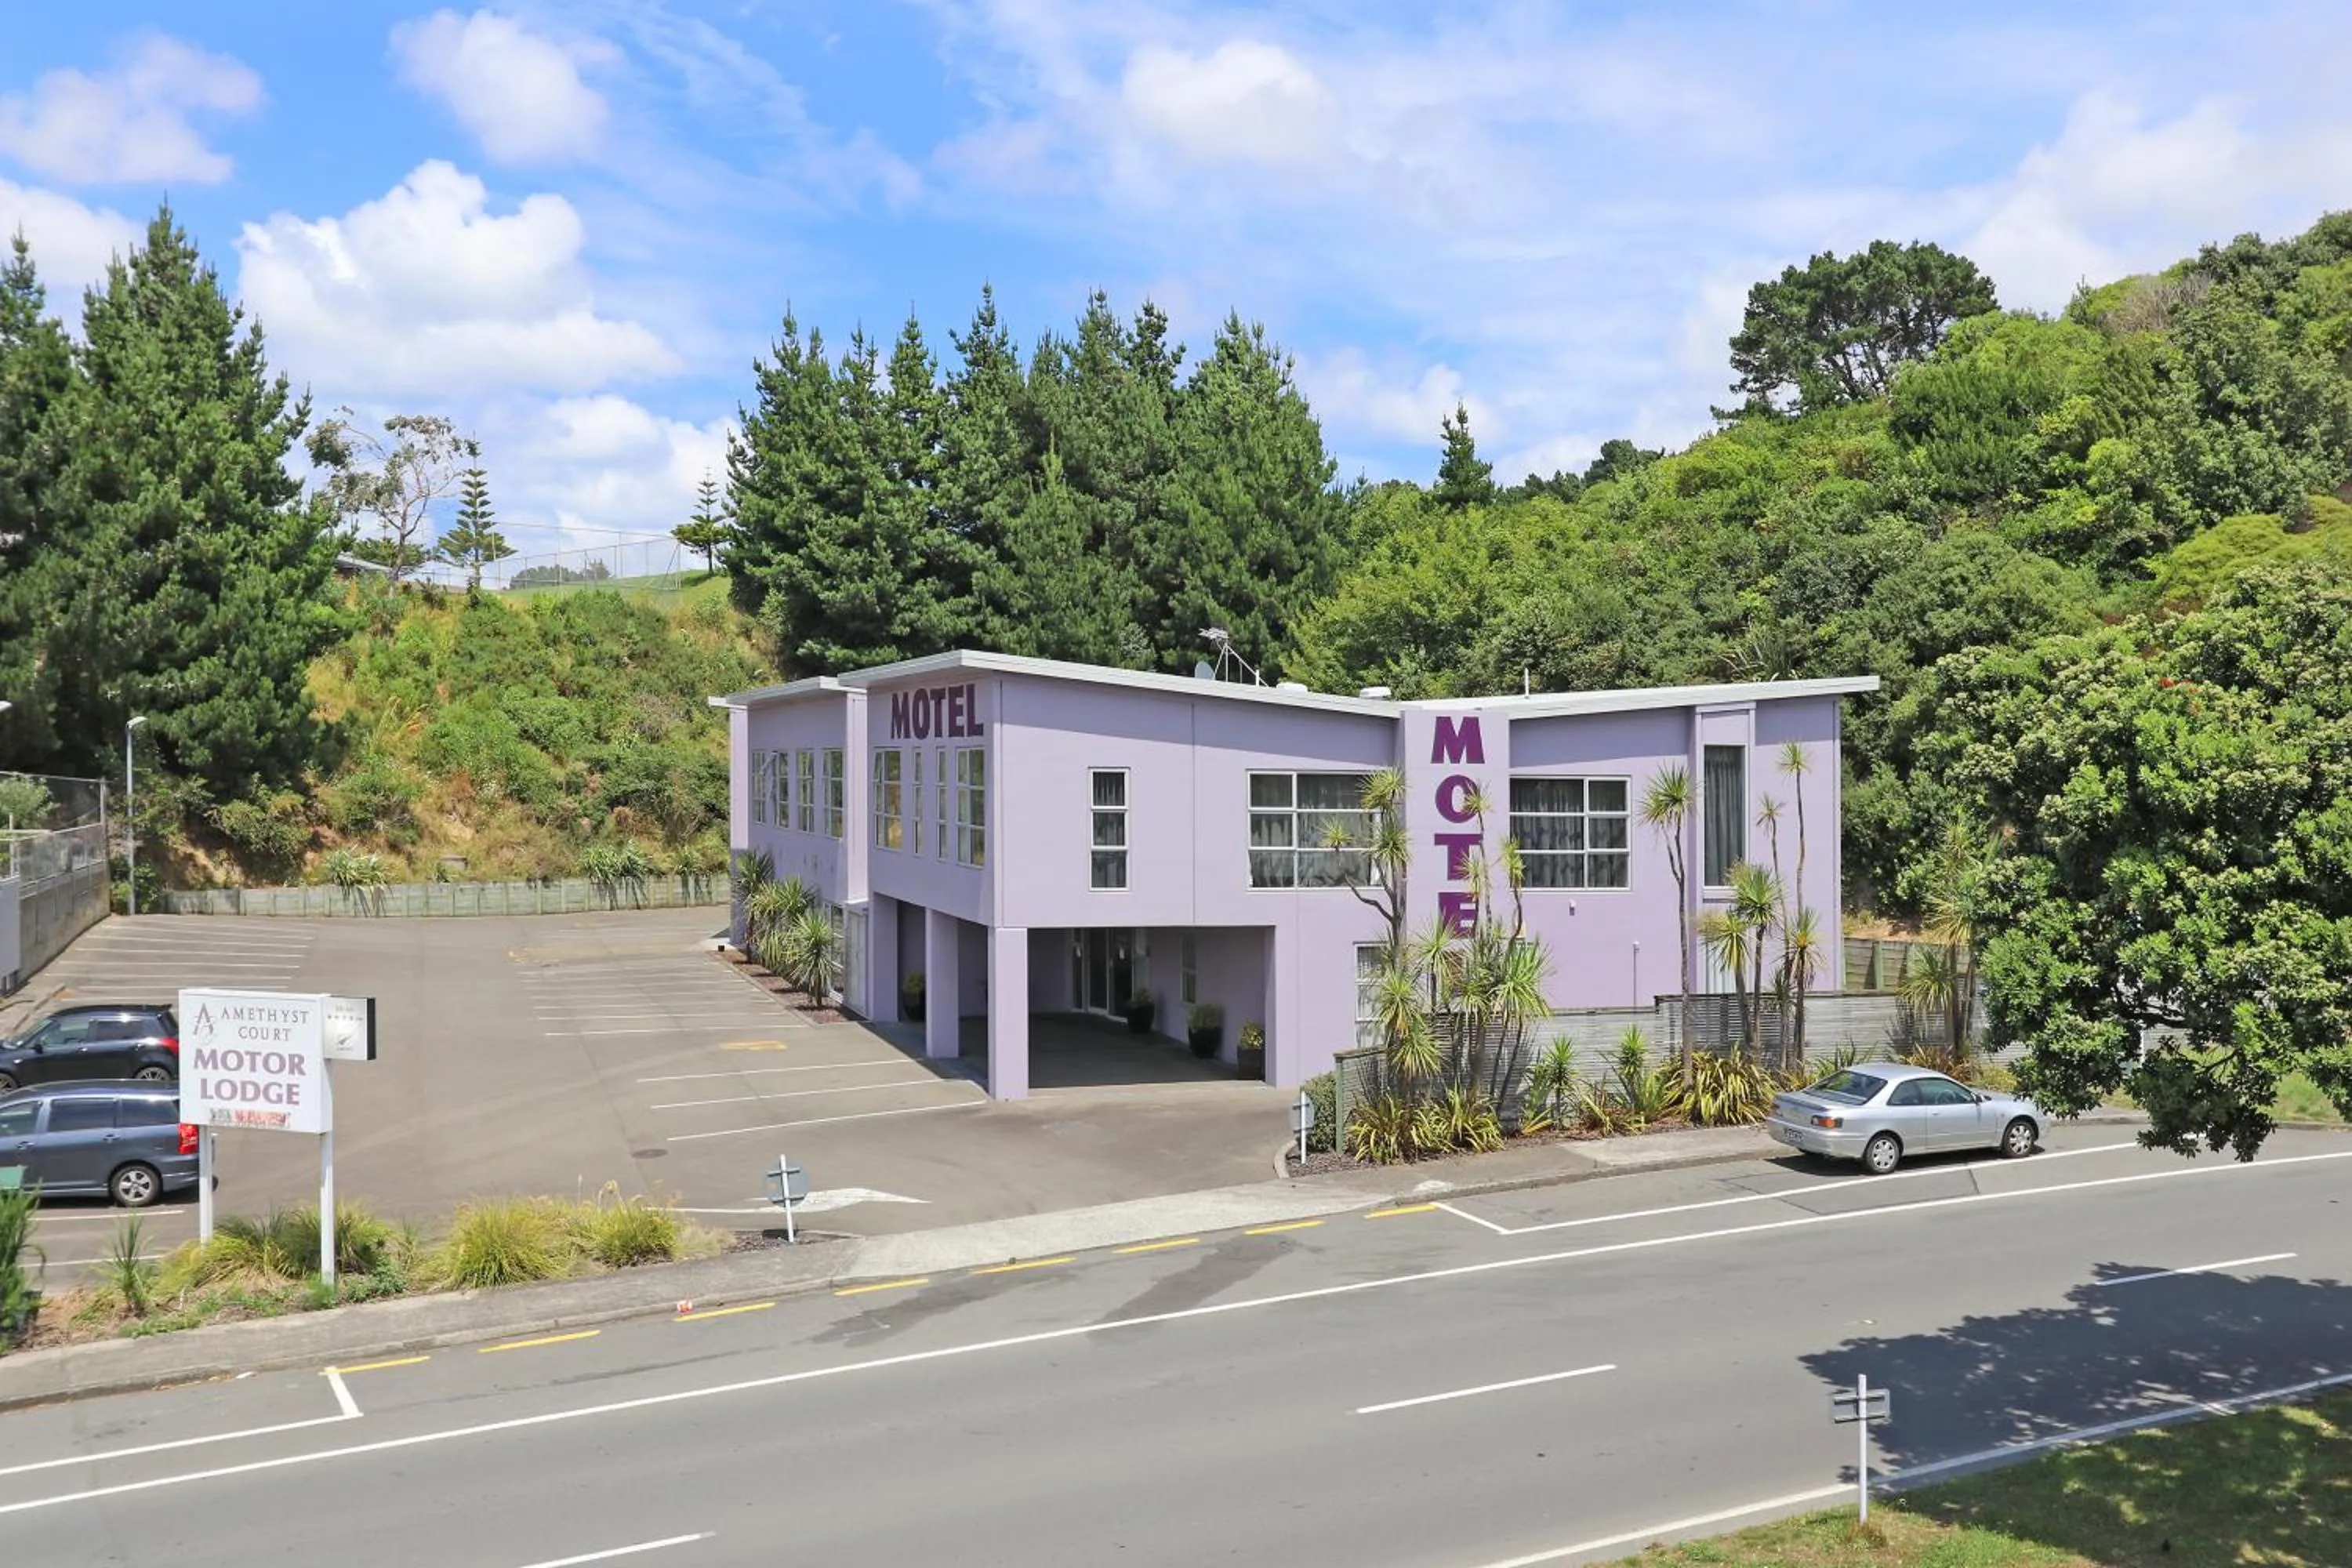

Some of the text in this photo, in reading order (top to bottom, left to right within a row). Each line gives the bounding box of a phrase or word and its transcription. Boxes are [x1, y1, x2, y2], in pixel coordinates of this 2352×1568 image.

[891, 684, 984, 740] MOTEL
[1431, 716, 1486, 993] MOTE
[221, 1007, 309, 1024] AMETHYST
[238, 1026, 291, 1042] COURT
[193, 1048, 307, 1076] MOTOR
[200, 1078, 300, 1105] LODGE
